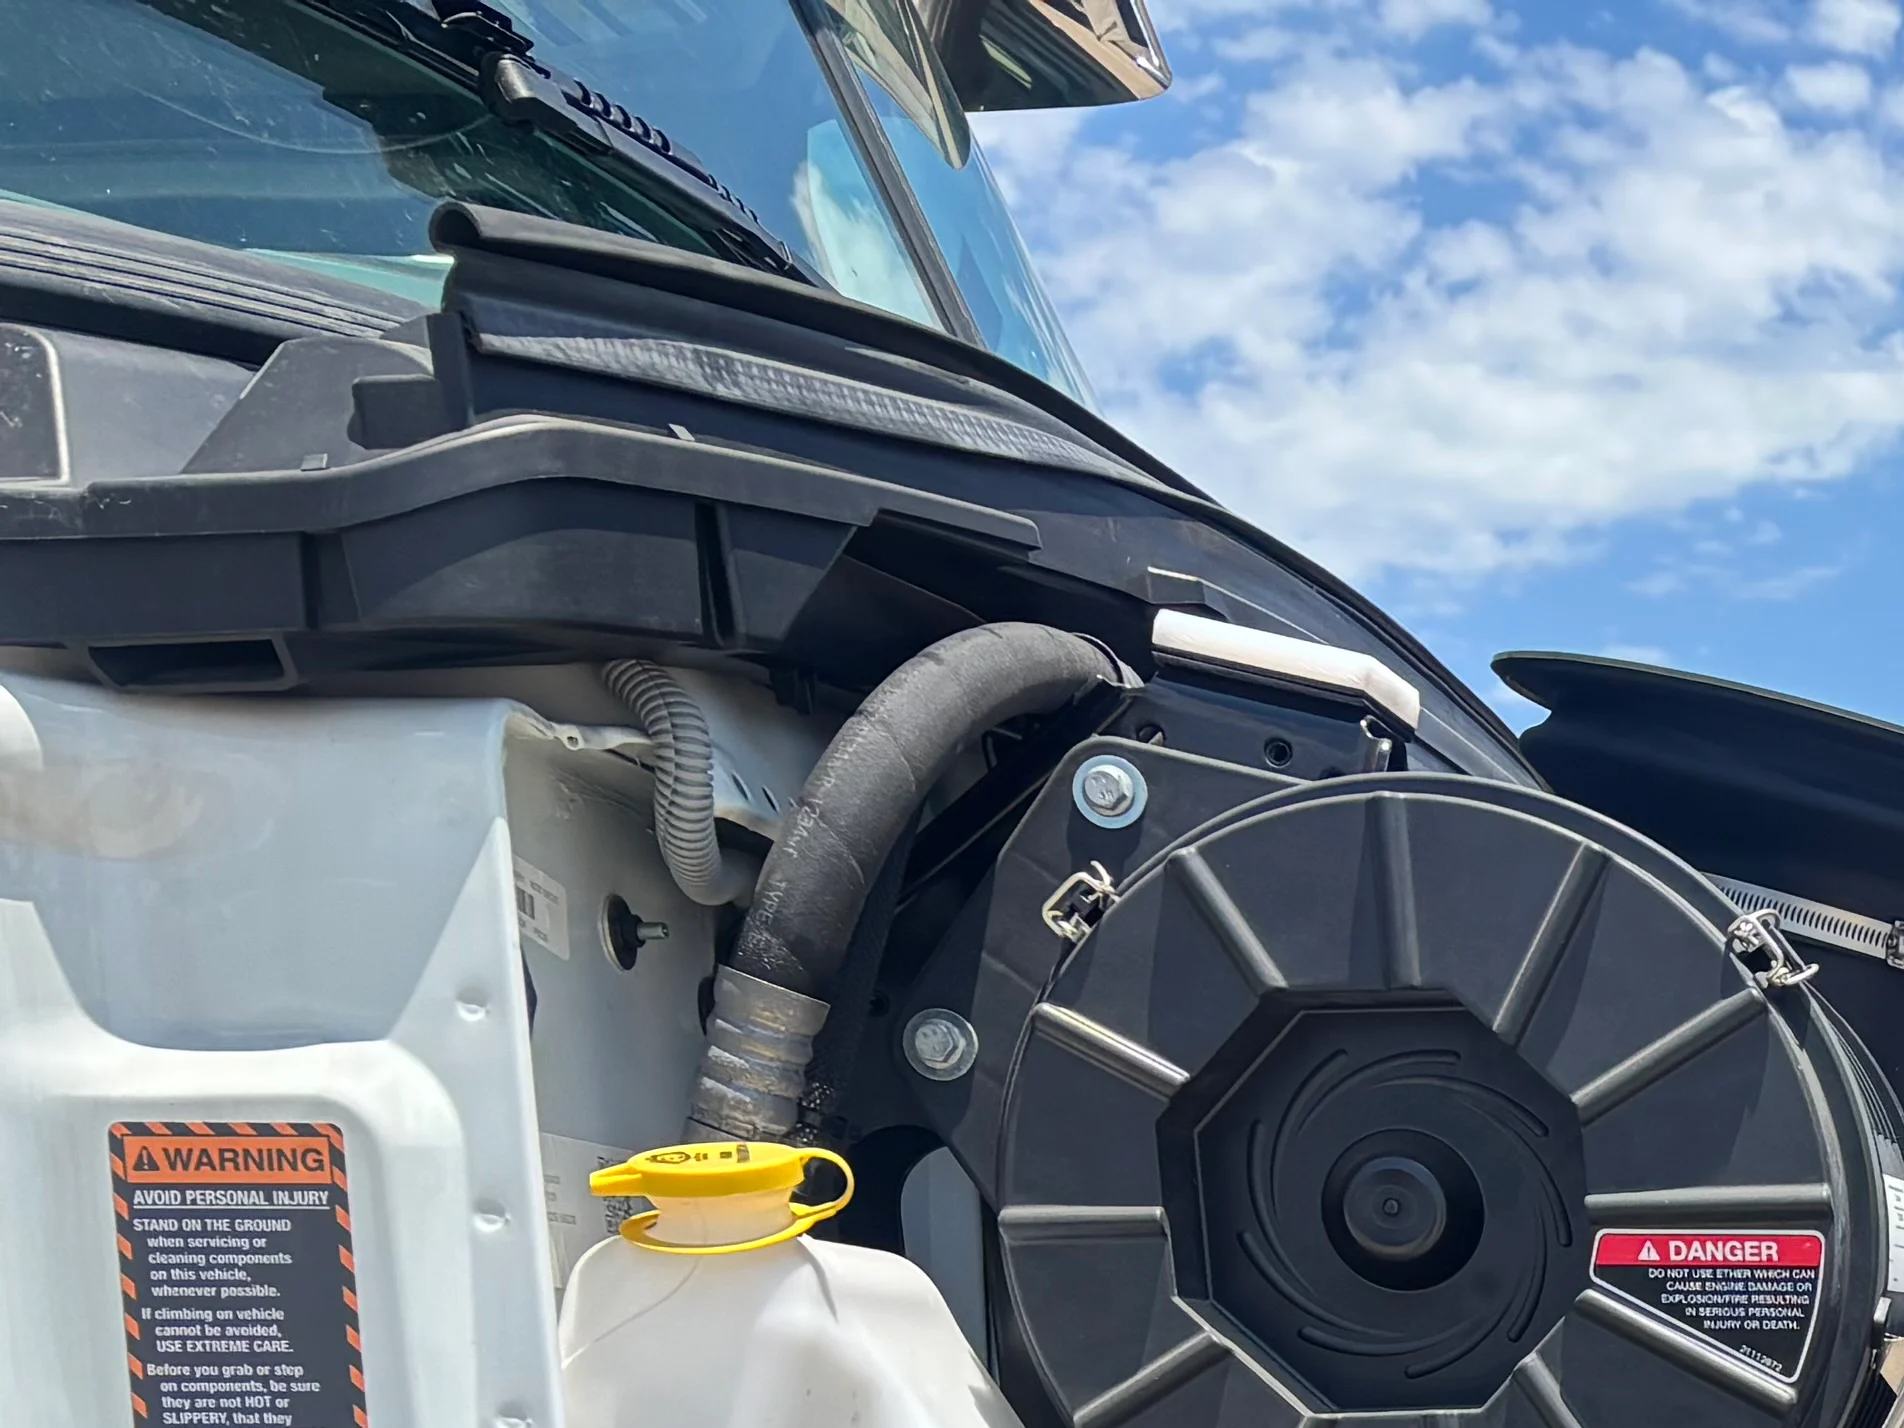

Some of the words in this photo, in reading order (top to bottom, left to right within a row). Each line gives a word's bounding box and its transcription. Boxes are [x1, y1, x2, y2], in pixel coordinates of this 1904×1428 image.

[162, 1148, 324, 1172] WARNING
[134, 1190, 181, 1205] AVOID
[186, 1191, 269, 1205] PERSONAL
[273, 1191, 328, 1205] INJURY
[133, 1219, 178, 1232] STAND
[182, 1219, 200, 1232] ON
[204, 1219, 230, 1232] THE
[235, 1220, 291, 1232] GROUND
[148, 1237, 184, 1247] when
[187, 1236, 249, 1250] servicing
[253, 1238, 267, 1248] or
[1669, 1240, 1779, 1262] DANGER
[148, 1253, 206, 1266] cleaning
[209, 1253, 292, 1266] components
[151, 1271, 166, 1280] on
[171, 1269, 196, 1280] this
[200, 1269, 251, 1281] vehicle,
[1649, 1269, 1664, 1279] DO
[1667, 1269, 1688, 1279] NOT
[1692, 1269, 1713, 1279] USE
[1717, 1269, 1749, 1279] ETHER
[1754, 1269, 1789, 1279] WHICH
[1793, 1269, 1815, 1279] CAN
[152, 1286, 216, 1297] whenever
[221, 1285, 280, 1298] possible.
[1666, 1282, 1702, 1291] CAUSE
[1706, 1282, 1746, 1291] ENGINE
[1749, 1282, 1793, 1292] DAMAGE
[1797, 1283, 1812, 1291] OR
[1751, 1295, 1809, 1304] RESULTING
[142, 1308, 151, 1320] If
[155, 1308, 213, 1322] climbing
[217, 1310, 233, 1320] on
[237, 1308, 284, 1320] vehicle
[1686, 1307, 1695, 1316] IN
[1699, 1308, 1745, 1317] SERIOUS
[1749, 1308, 1804, 1317] PERSONAL
[1704, 1320, 1741, 1329] INJURY
[1744, 1320, 1760, 1329] OR
[1763, 1320, 1800, 1329] DEATH.
[155, 1326, 202, 1336] cannot
[205, 1325, 221, 1336] be
[226, 1325, 282, 1338] avoided,
[157, 1341, 182, 1352] USE
[187, 1341, 249, 1352] EXTREME
[254, 1341, 294, 1352] CARE.
[147, 1364, 190, 1376] Before
[194, 1366, 218, 1377] you
[222, 1364, 252, 1378] grab
[257, 1366, 271, 1376] or
[274, 1366, 303, 1378] step
[160, 1383, 177, 1392] on
[181, 1381, 267, 1394] components,
[270, 1381, 286, 1392] be
[291, 1383, 320, 1392] sure
[162, 1397, 190, 1410] they
[195, 1399, 215, 1408] are
[220, 1397, 241, 1408] not
[245, 1396, 271, 1408] HOT
[276, 1399, 290, 1408] or
[163, 1413, 229, 1426] SLIPPERY,
[233, 1413, 259, 1424] that
[264, 1413, 292, 1426] they
